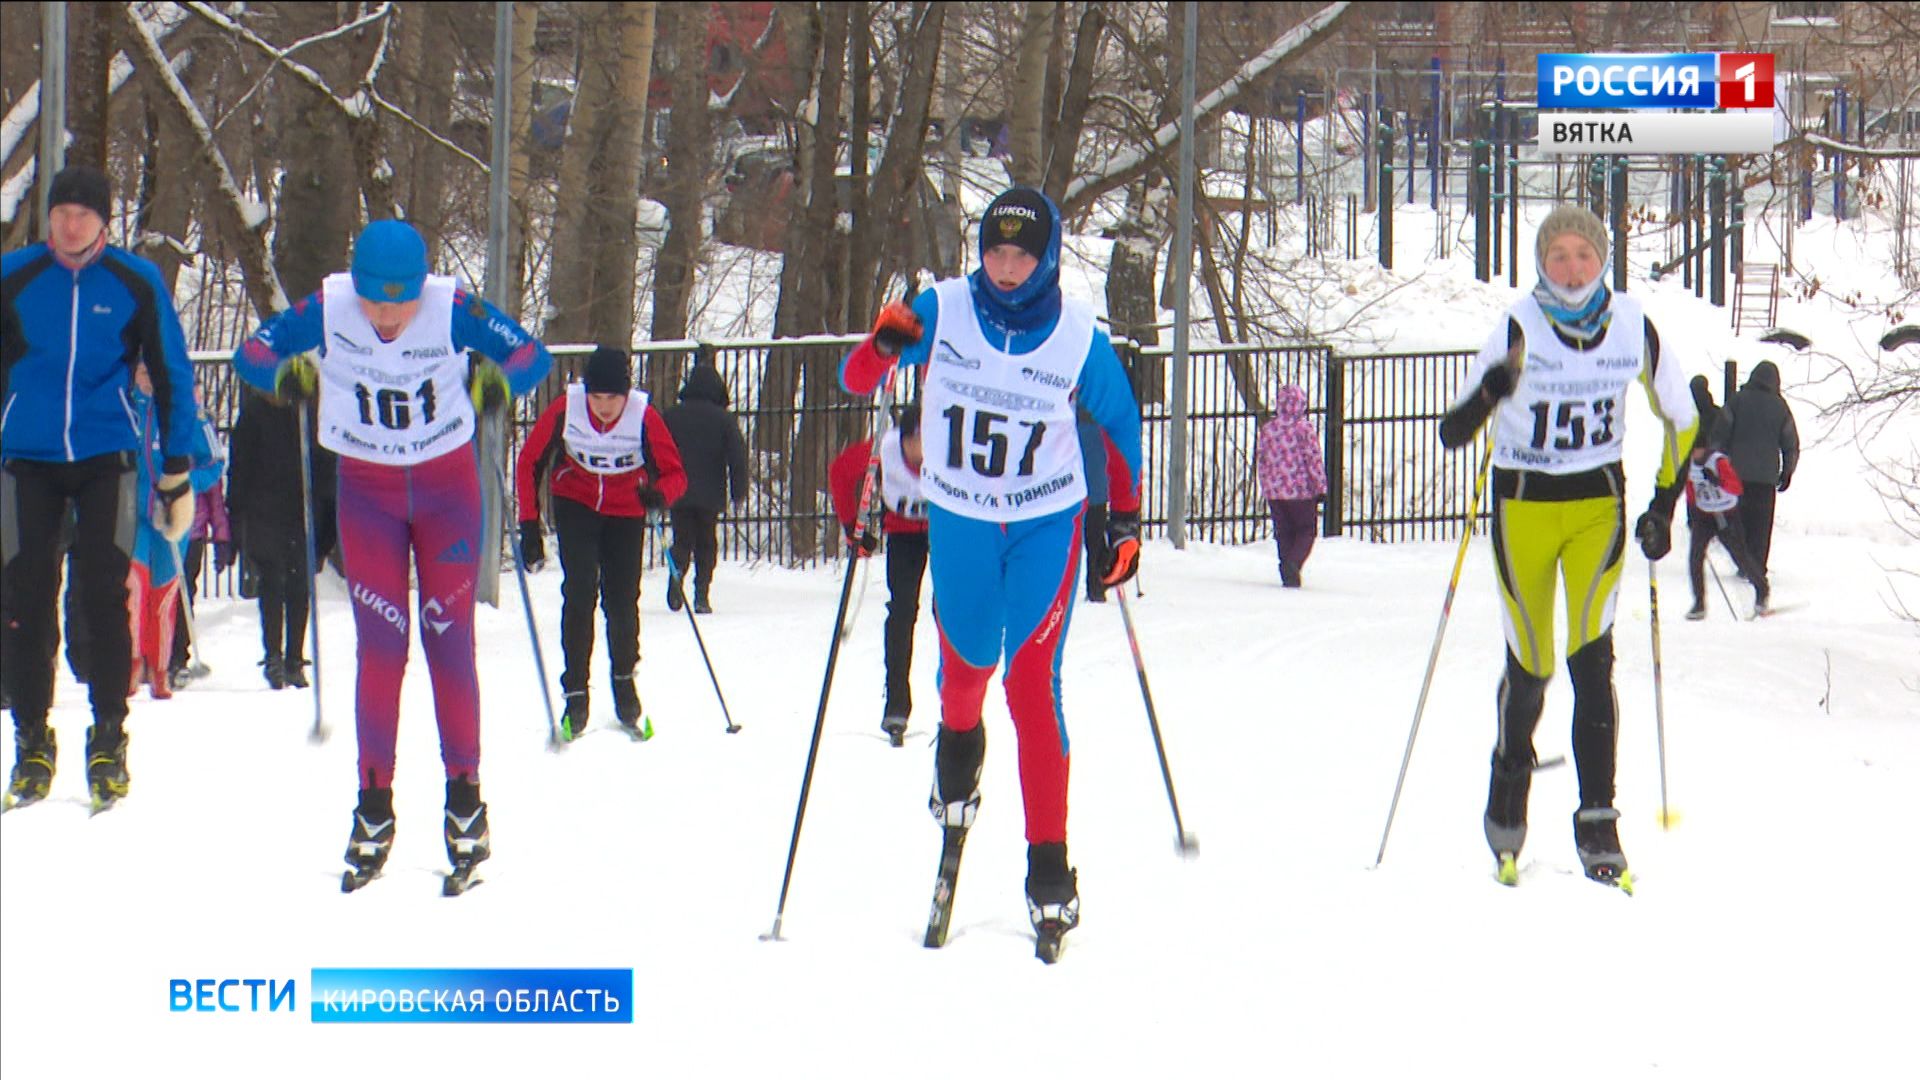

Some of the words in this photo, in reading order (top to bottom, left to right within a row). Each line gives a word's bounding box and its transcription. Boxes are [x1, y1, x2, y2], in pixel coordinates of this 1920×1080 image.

[992, 205, 1037, 221] LUKOIL
[355, 378, 436, 430] 161
[1529, 397, 1615, 450] 153
[943, 404, 1046, 478] 157
[1005, 472, 1074, 508] Трамплин
